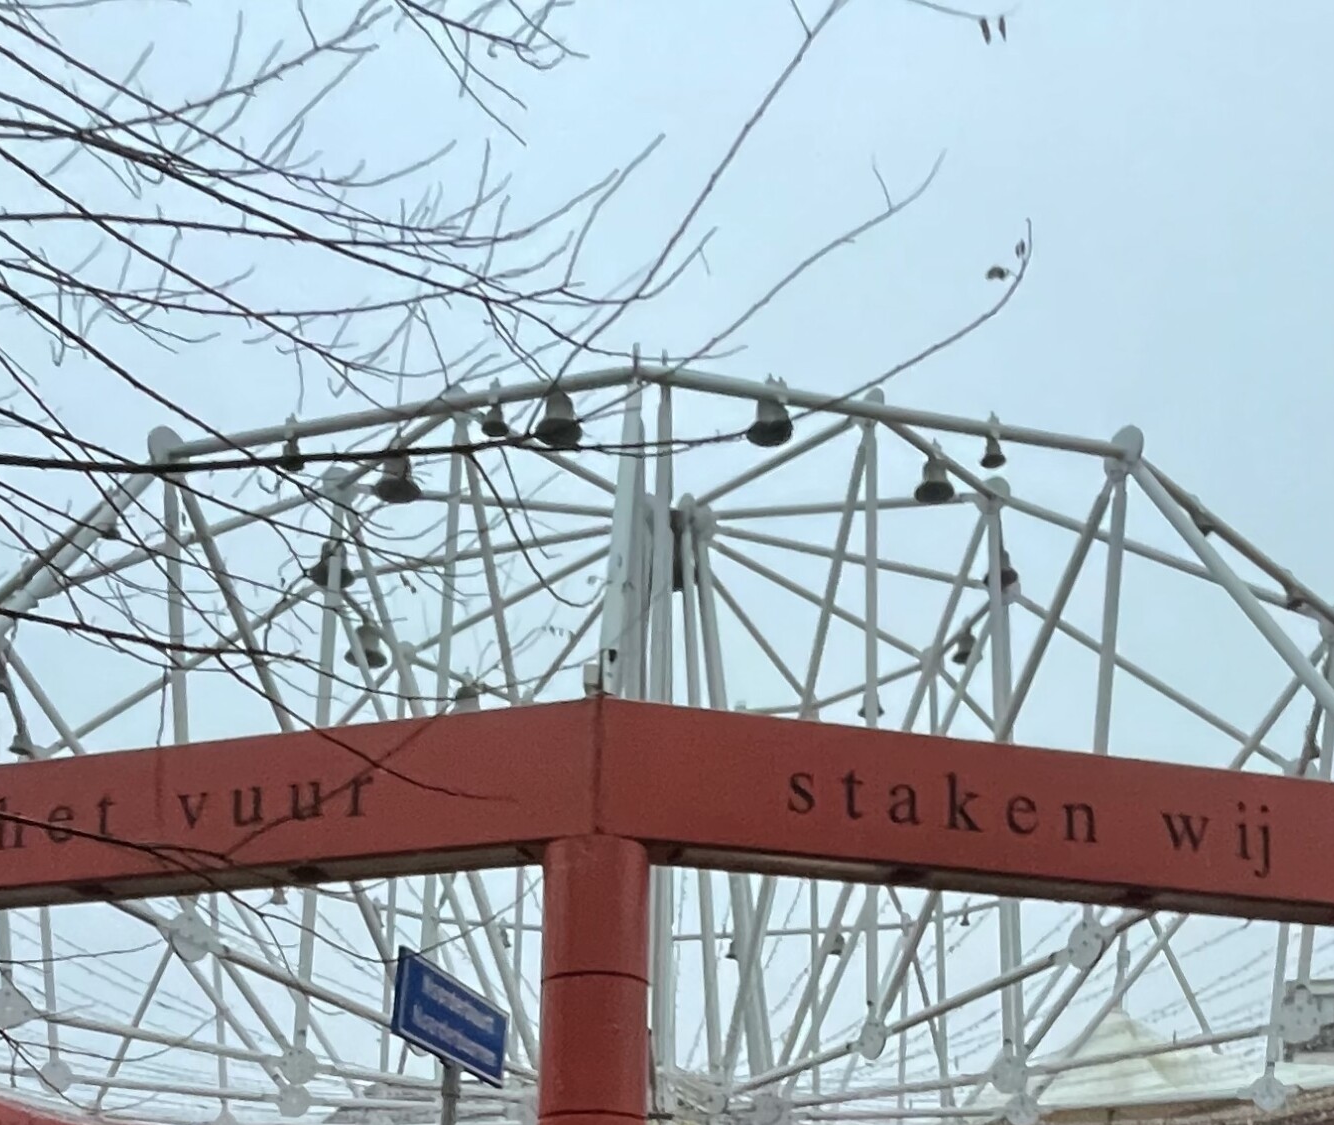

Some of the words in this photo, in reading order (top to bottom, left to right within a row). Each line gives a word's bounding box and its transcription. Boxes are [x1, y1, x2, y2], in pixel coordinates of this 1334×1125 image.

[178, 775, 374, 830] vuur
[786, 768, 1099, 845] staken
[1160, 800, 1272, 879] wij
